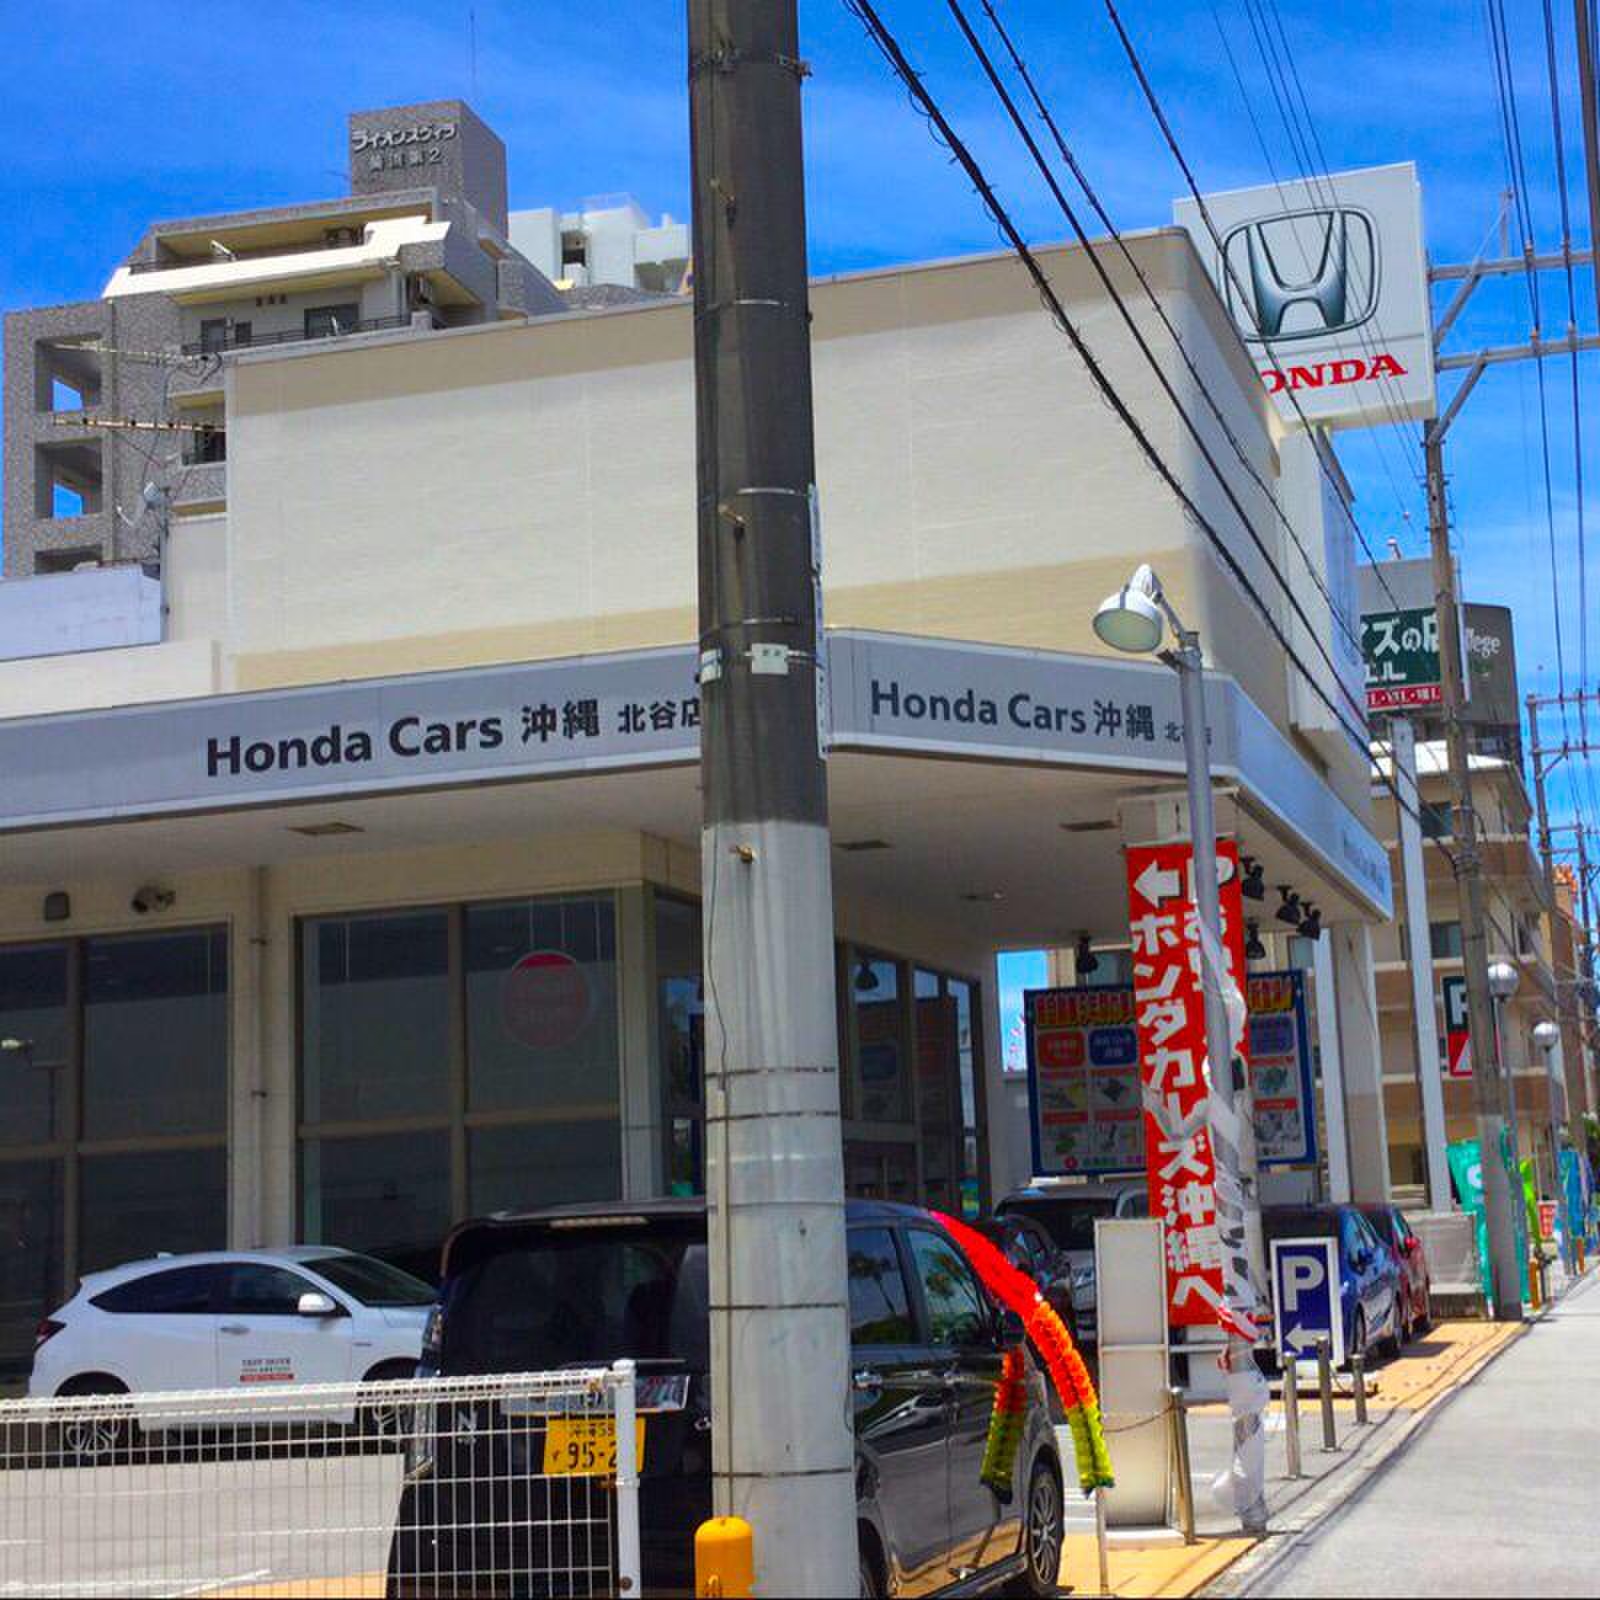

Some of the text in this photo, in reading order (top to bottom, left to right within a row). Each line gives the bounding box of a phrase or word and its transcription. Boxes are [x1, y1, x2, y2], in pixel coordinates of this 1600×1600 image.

[1260, 354, 1407, 394] ONDA
[207, 697, 701, 777] Honda Cars 沖縄 北谷店
[870, 680, 997, 725] Honda
[1008, 694, 1086, 734] Cars
[1093, 700, 1155, 741] 沖縄
[1281, 1255, 1324, 1312] P
[568, 1441, 617, 1469] 95-2
